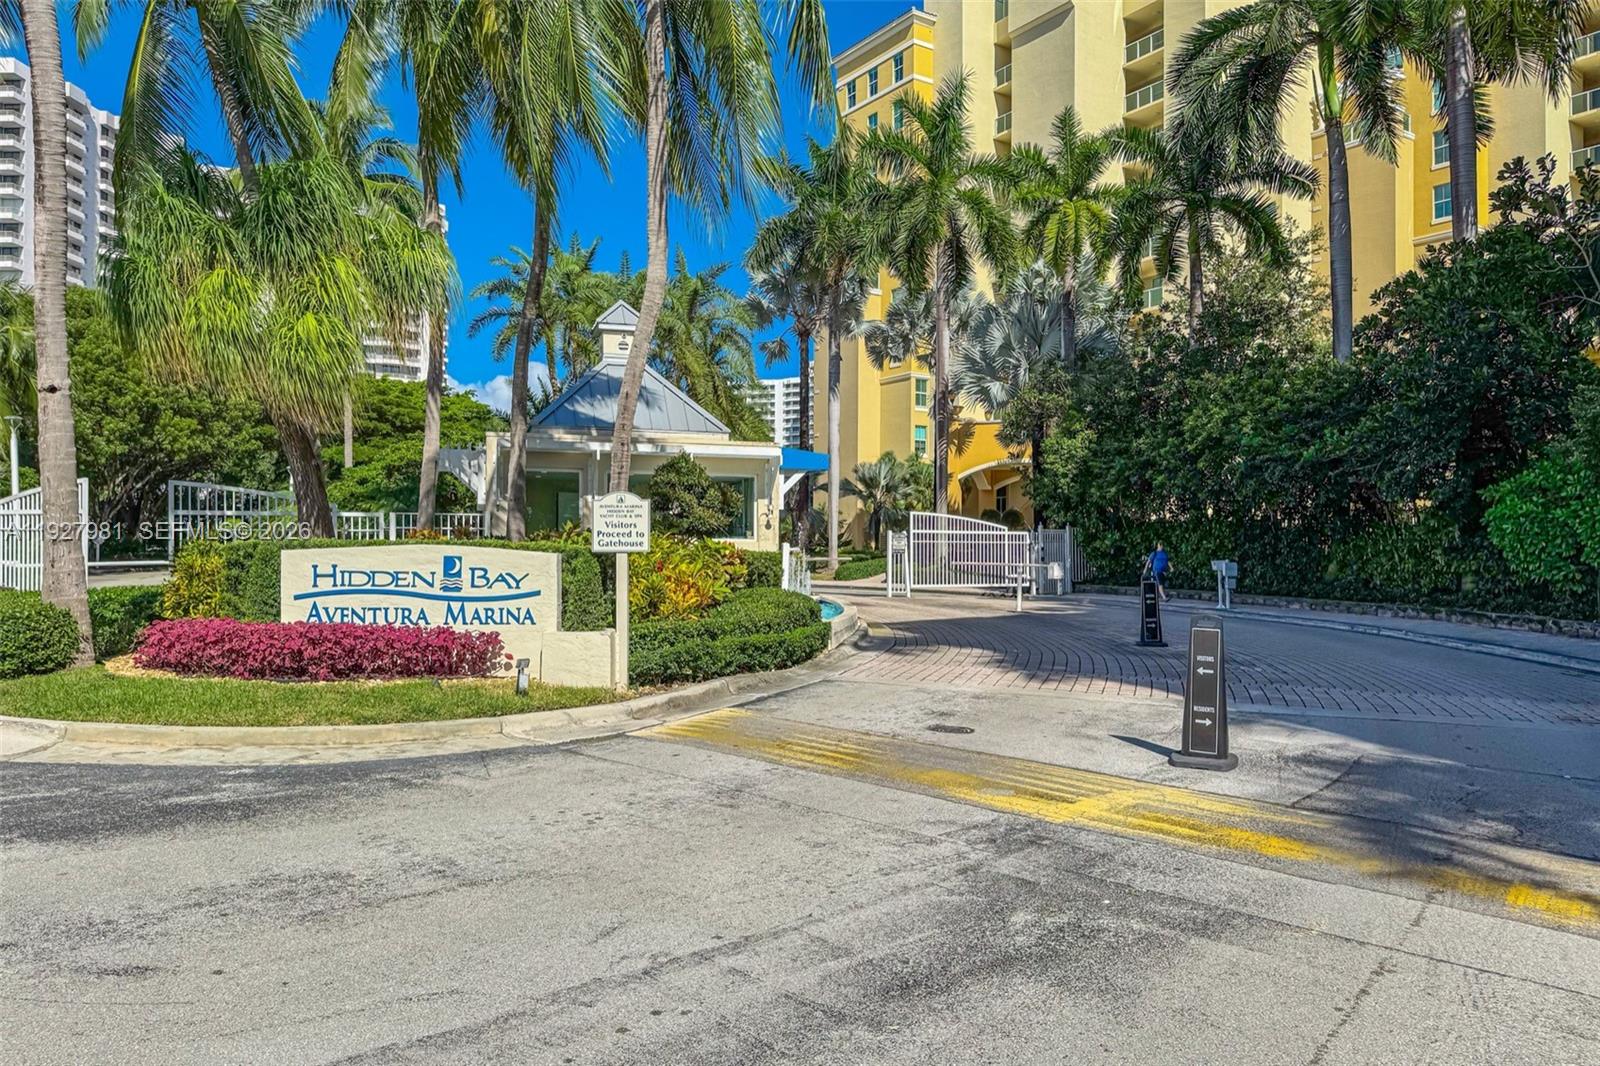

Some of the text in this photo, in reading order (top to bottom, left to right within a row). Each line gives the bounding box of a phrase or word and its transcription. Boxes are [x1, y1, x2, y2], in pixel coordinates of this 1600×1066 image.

[604, 520, 638, 529] Visitors
[596, 530, 633, 538] Proceed
[597, 539, 645, 547] Gatehouse
[311, 564, 530, 589] HIDDEN BAY
[306, 601, 537, 625] AVENTURA MARINA
[1196, 655, 1215, 663] VISITORS
[1193, 705, 1215, 713] RESIDENTS
